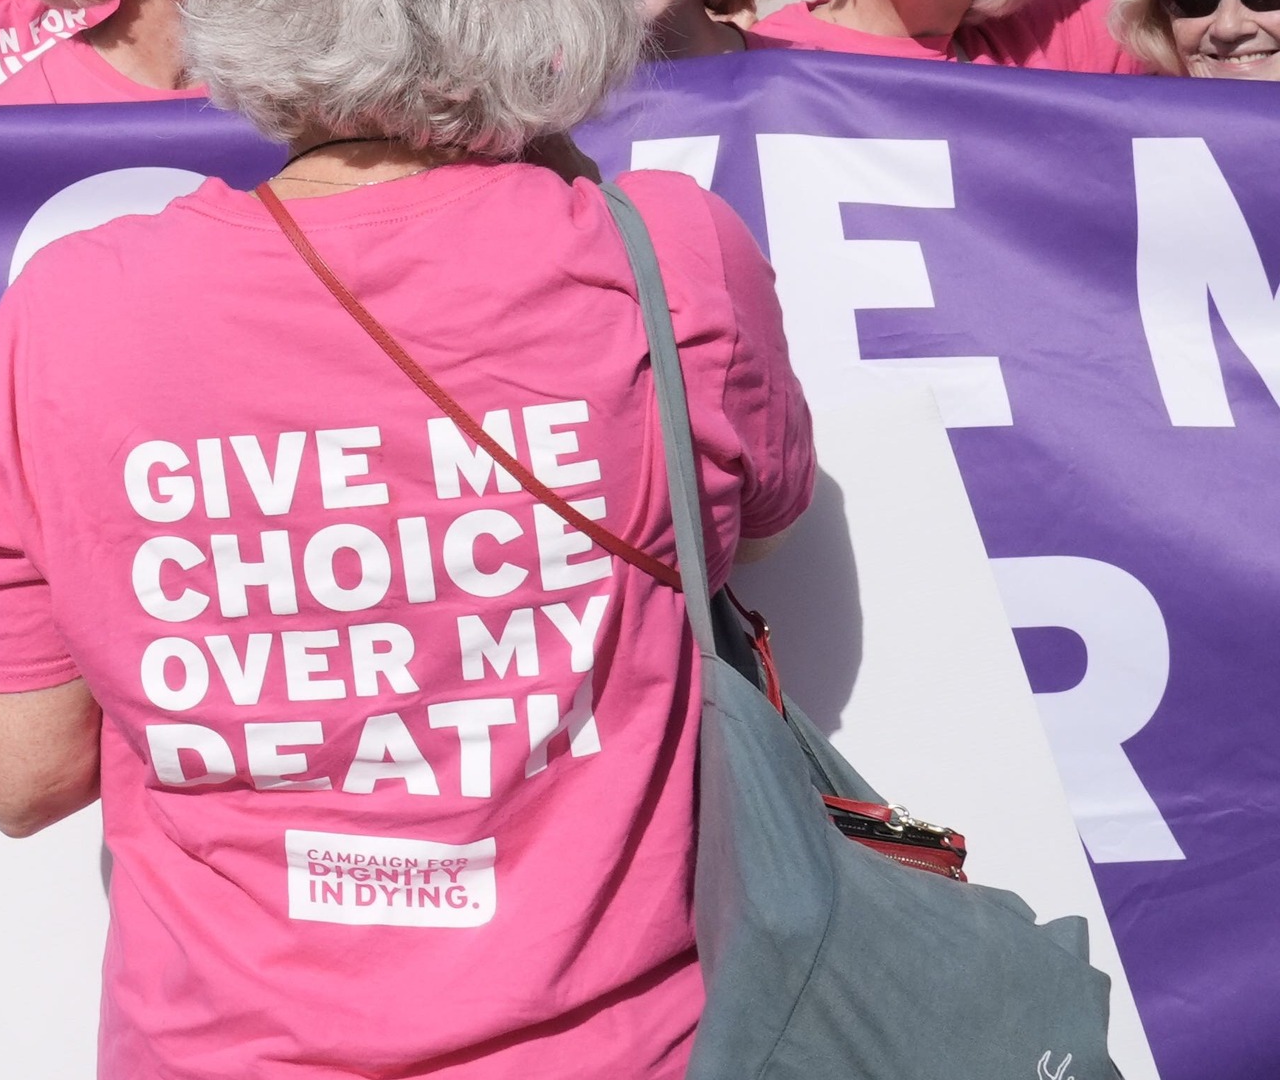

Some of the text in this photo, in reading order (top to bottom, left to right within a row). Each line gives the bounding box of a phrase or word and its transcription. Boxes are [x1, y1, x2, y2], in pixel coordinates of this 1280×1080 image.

[122, 400, 603, 522] GIVE ME
[130, 497, 614, 624] CHOICE
[140, 595, 612, 712] OVER MY
[144, 690, 603, 798] DEATH
[307, 849, 469, 868] CAMPAIGN FOR
[308, 861, 466, 886] DIGNITY
[309, 880, 480, 909] IN DYING.
